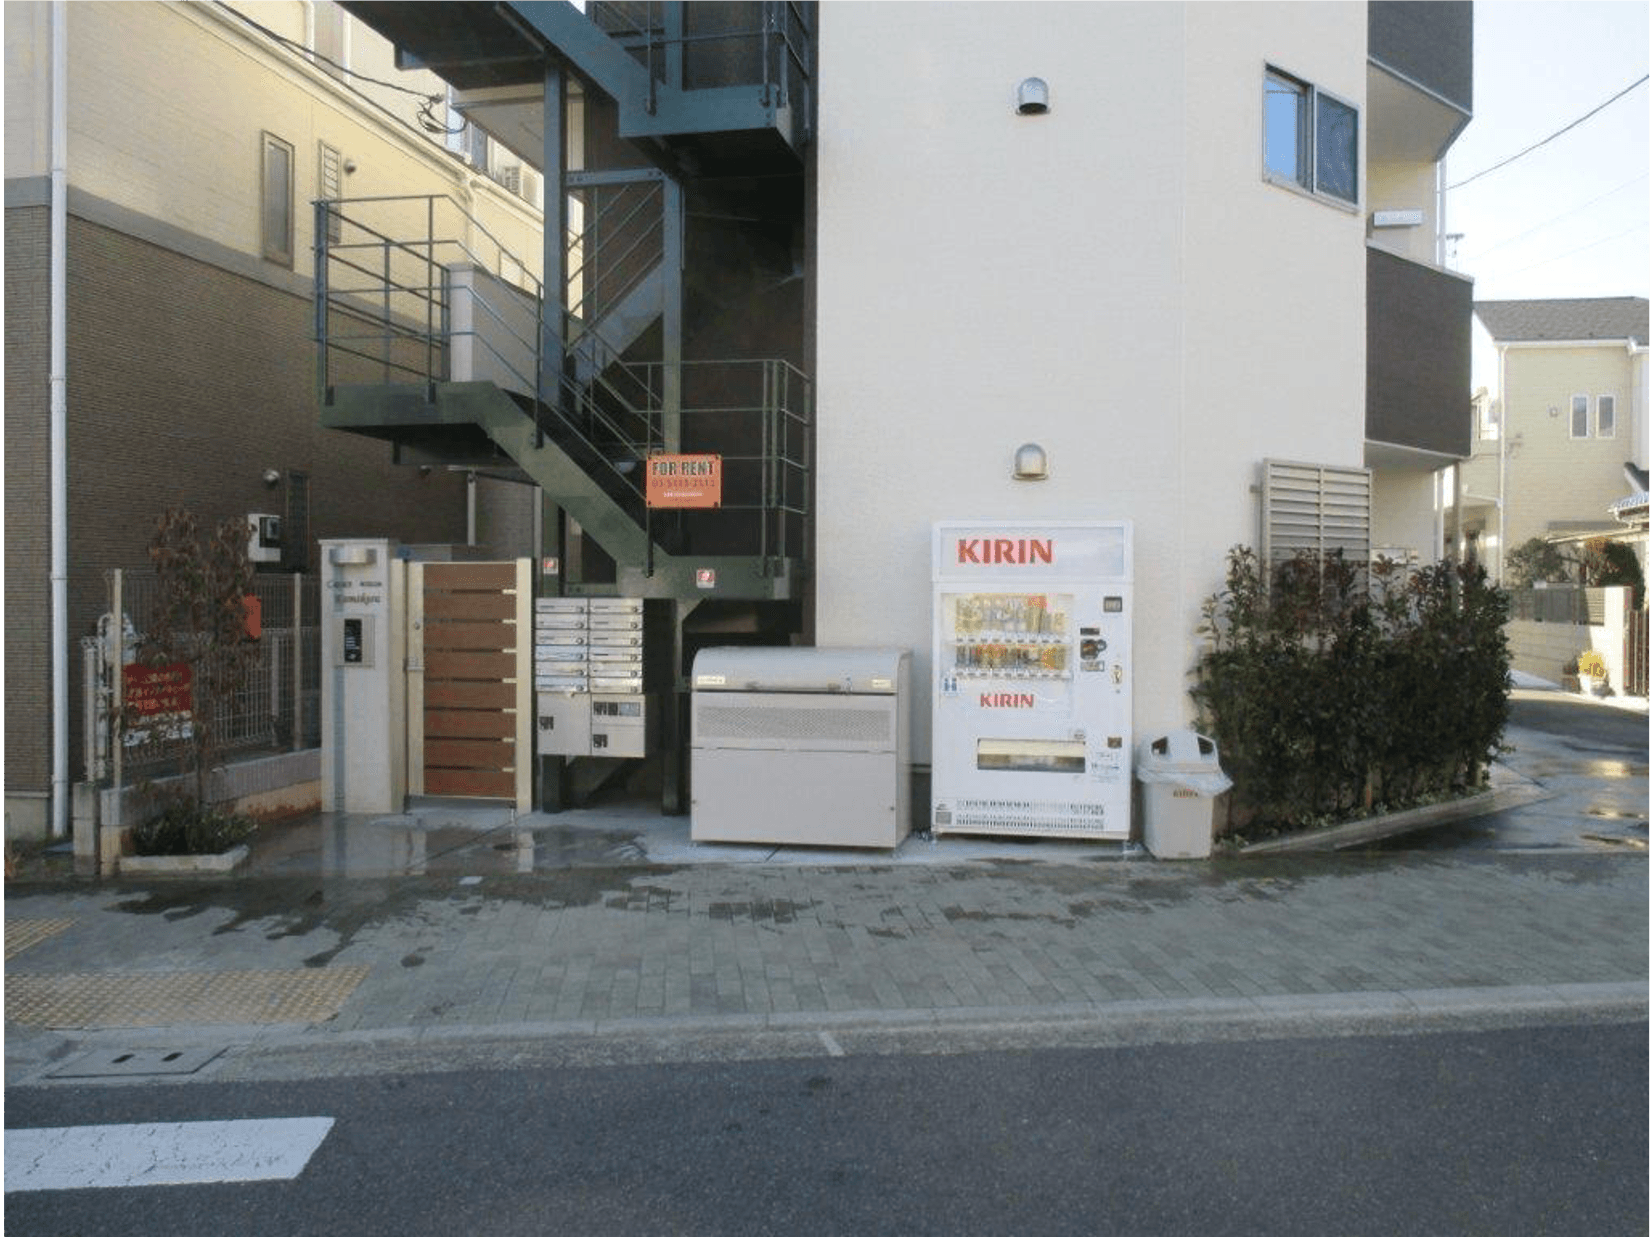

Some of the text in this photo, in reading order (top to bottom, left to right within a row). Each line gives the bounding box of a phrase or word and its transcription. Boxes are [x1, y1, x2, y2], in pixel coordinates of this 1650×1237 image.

[653, 461, 713, 475] FOR RENT
[958, 539, 1052, 564] KIRIN
[980, 693, 1034, 708] KIRIN
